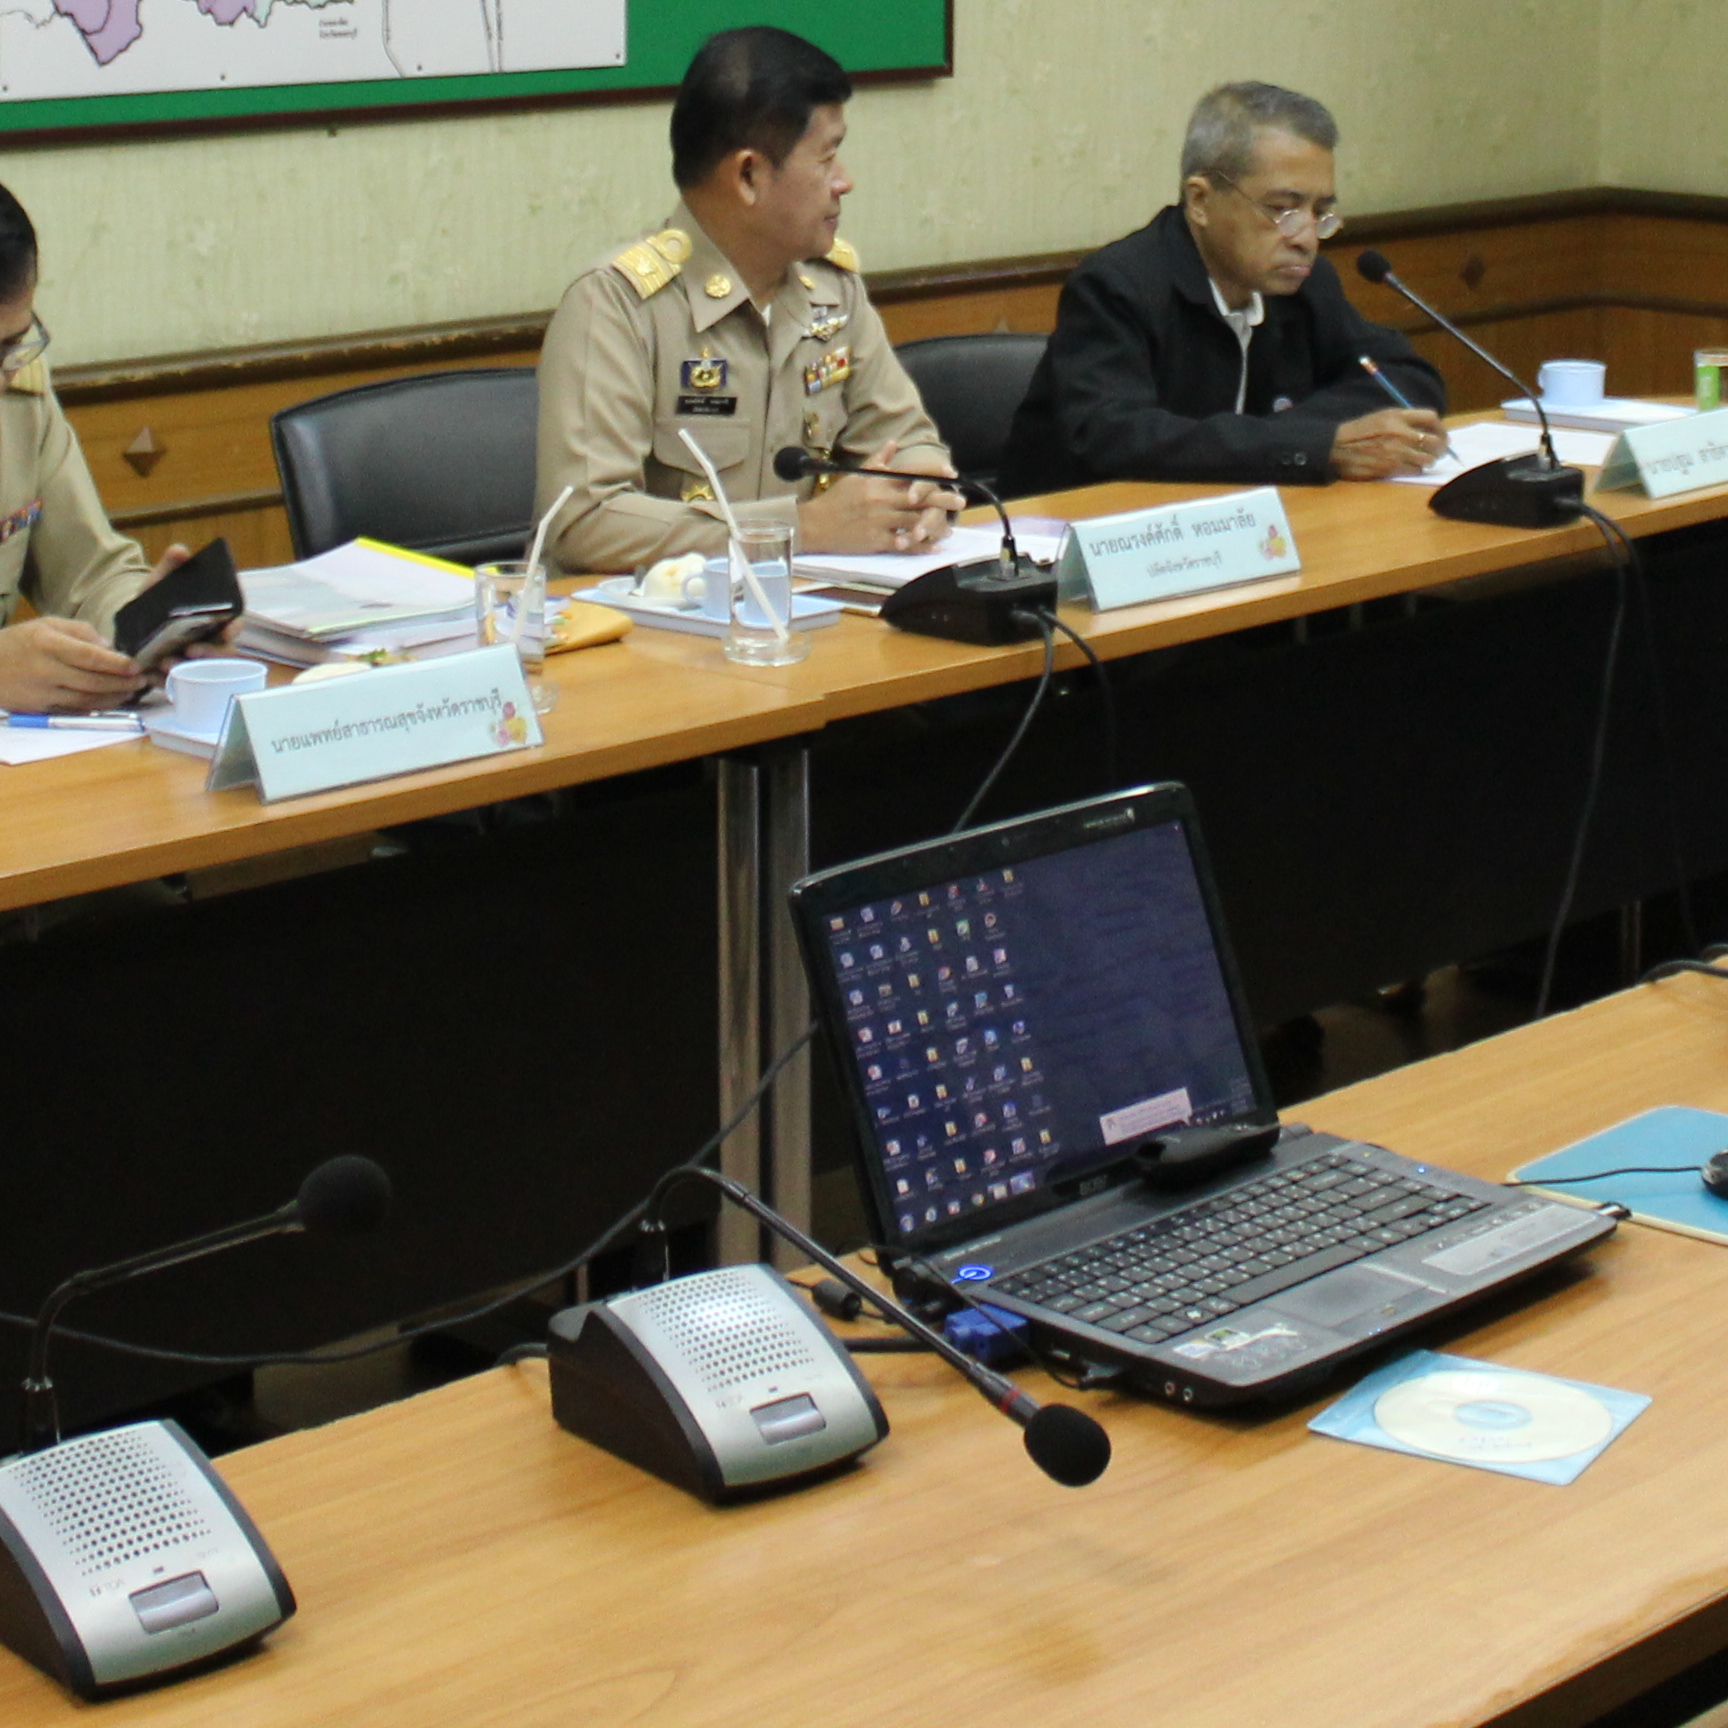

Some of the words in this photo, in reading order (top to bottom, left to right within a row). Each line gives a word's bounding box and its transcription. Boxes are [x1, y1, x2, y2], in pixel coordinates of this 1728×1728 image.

[271, 687, 503, 754] นายแพทย์สาธารณสุขจังหวัดราชบุรี
